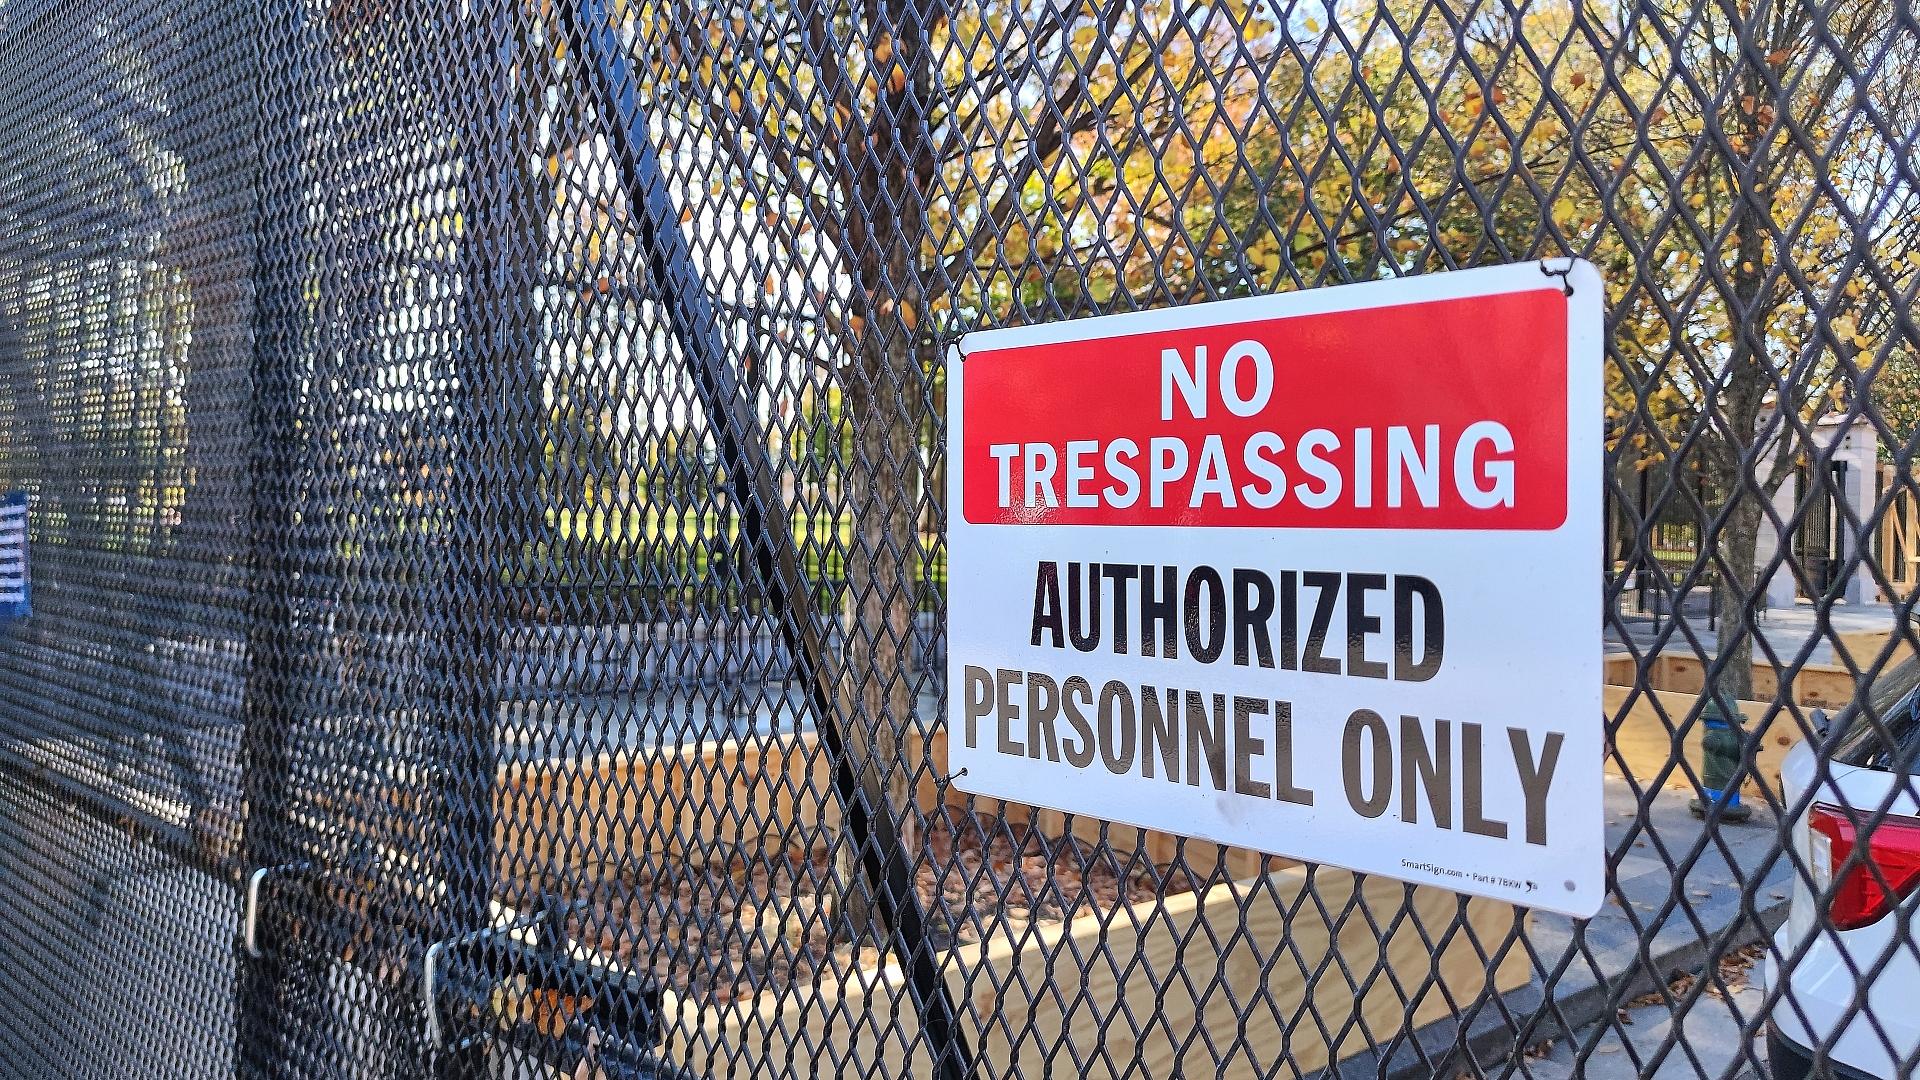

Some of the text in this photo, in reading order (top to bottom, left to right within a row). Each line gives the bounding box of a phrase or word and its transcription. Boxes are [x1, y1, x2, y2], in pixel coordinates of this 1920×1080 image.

[1160, 339, 1275, 421] NO
[989, 420, 1516, 509] TRESPASSING
[1030, 560, 1445, 683] AUTHORIZED
[964, 664, 1566, 847] PERSONNEL ONLY
[1401, 858, 1463, 878] SmartSign.com
[1472, 872, 1489, 884] Part
